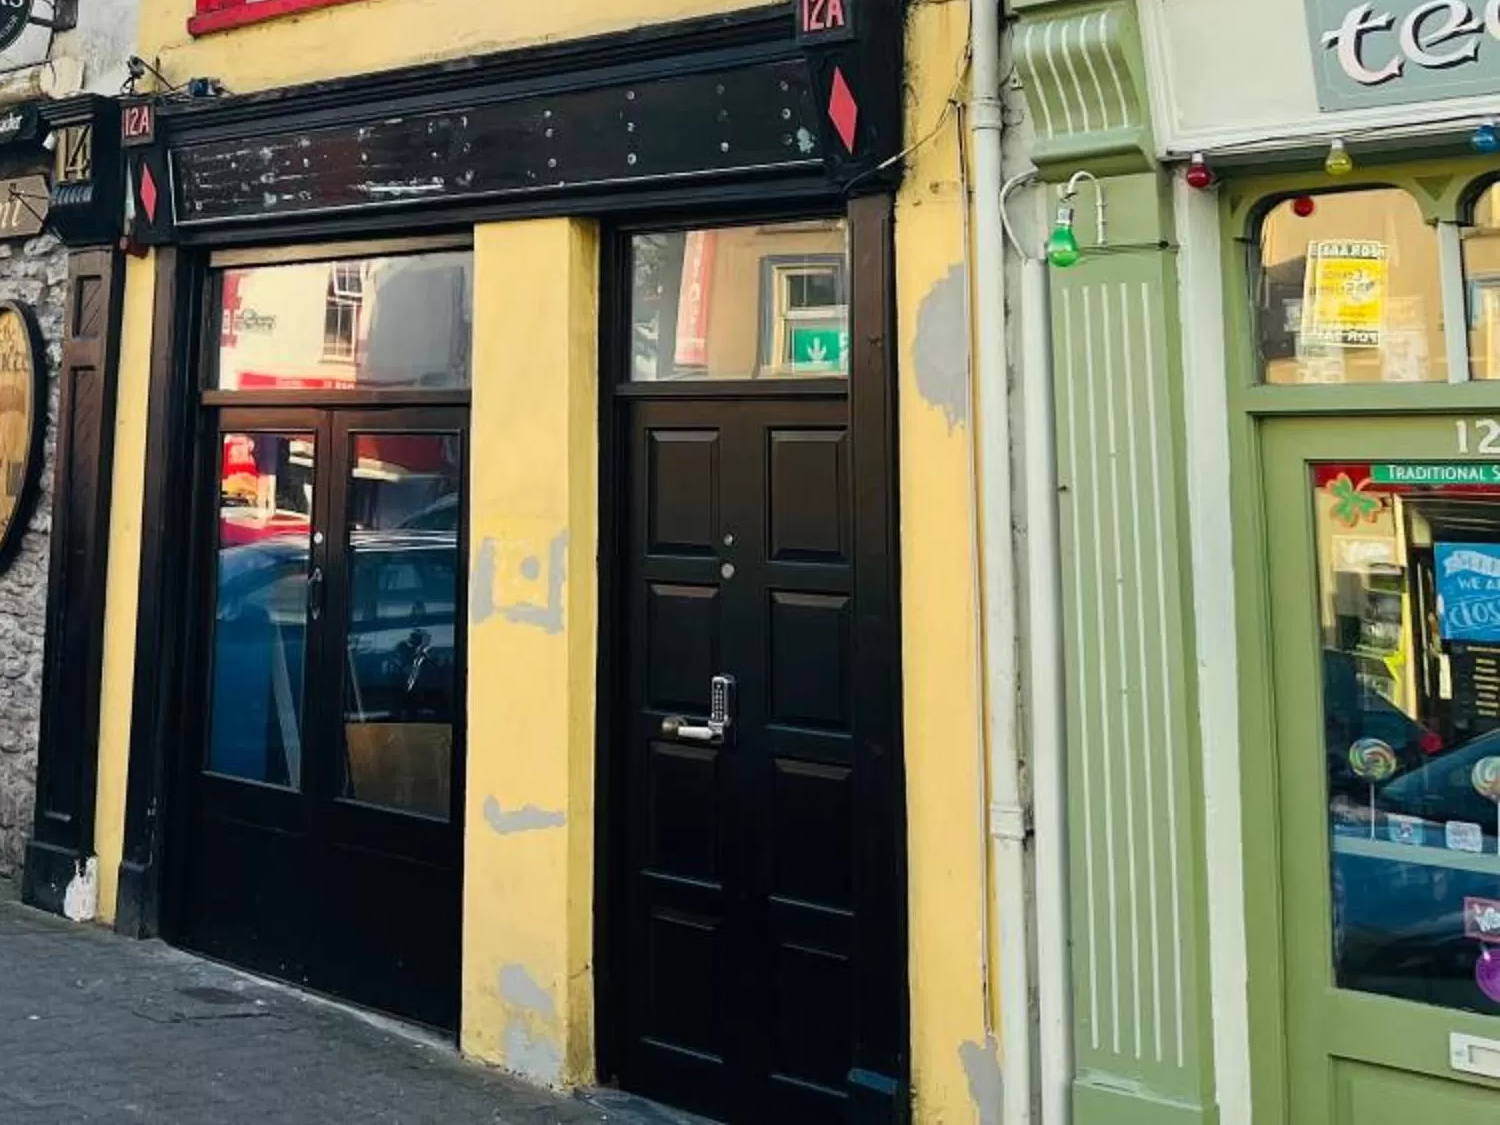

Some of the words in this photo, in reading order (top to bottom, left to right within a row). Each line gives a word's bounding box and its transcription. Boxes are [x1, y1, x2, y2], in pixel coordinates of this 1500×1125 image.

[124, 107, 149, 136] 12A
[56, 125, 92, 182] 14
[1388, 465, 1486, 480] TRADITIONAL
